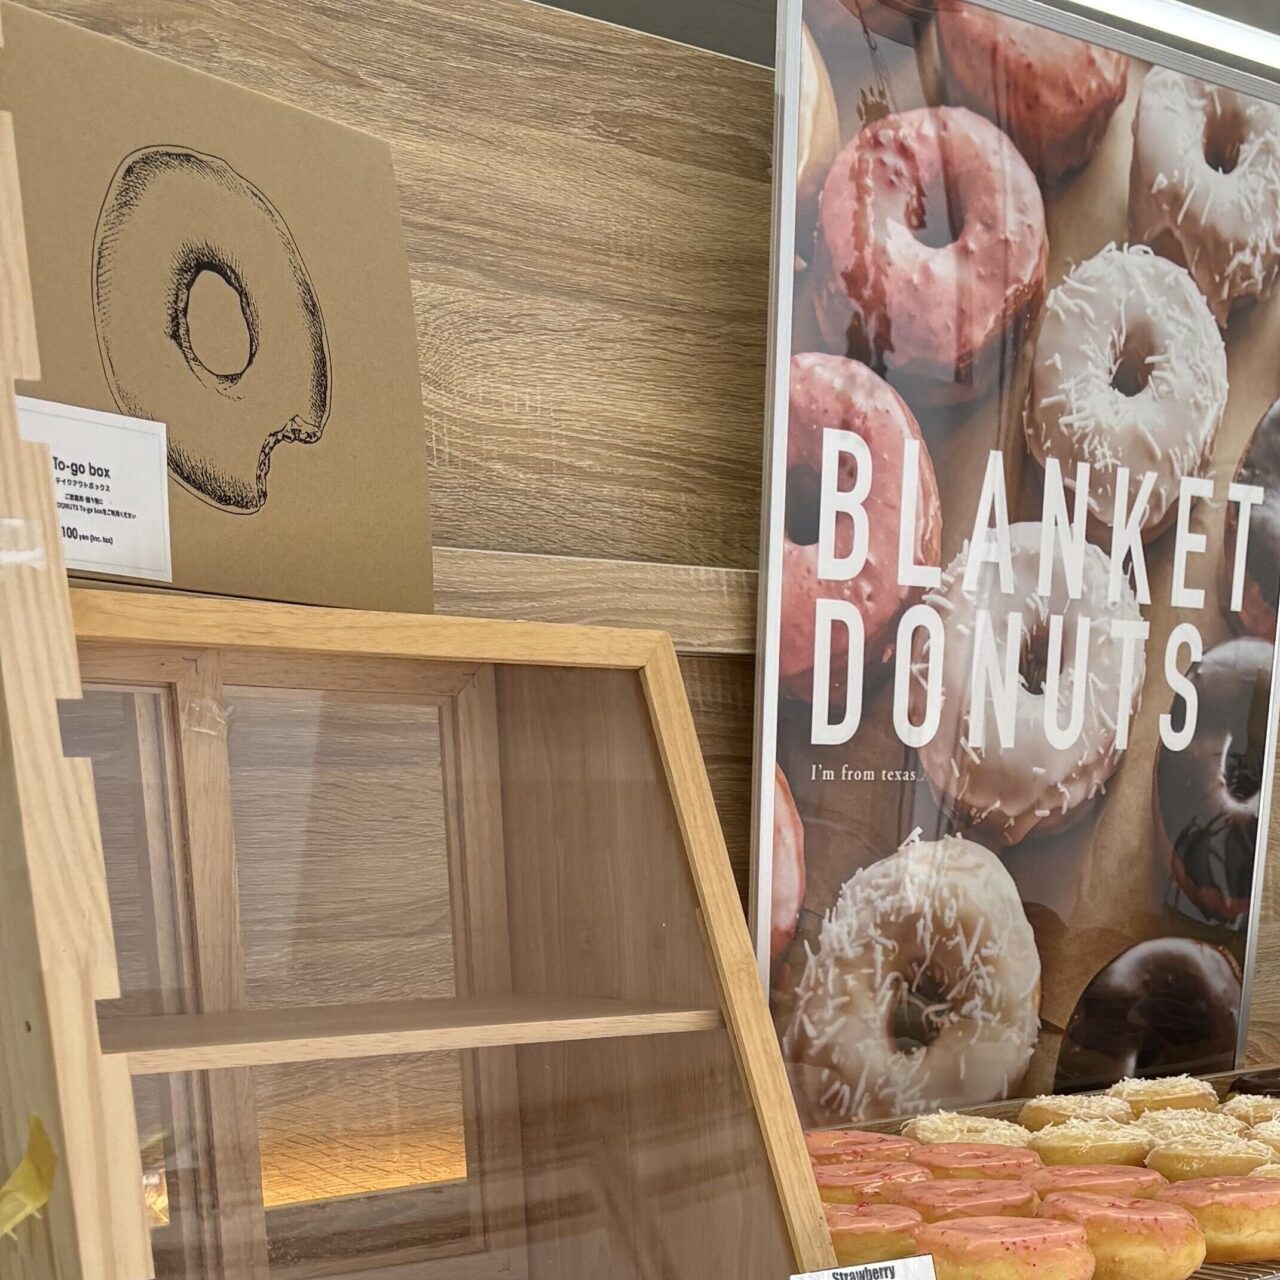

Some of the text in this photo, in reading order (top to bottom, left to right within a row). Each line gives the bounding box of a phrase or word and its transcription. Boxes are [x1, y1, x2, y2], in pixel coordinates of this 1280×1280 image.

[52, 456, 111, 478] To-go box
[816, 427, 1264, 612] BLANKET
[61, 526, 78, 540] 100
[810, 598, 1203, 752] DONUTS
[841, 763, 875, 781] from
[881, 769, 917, 781] texas
